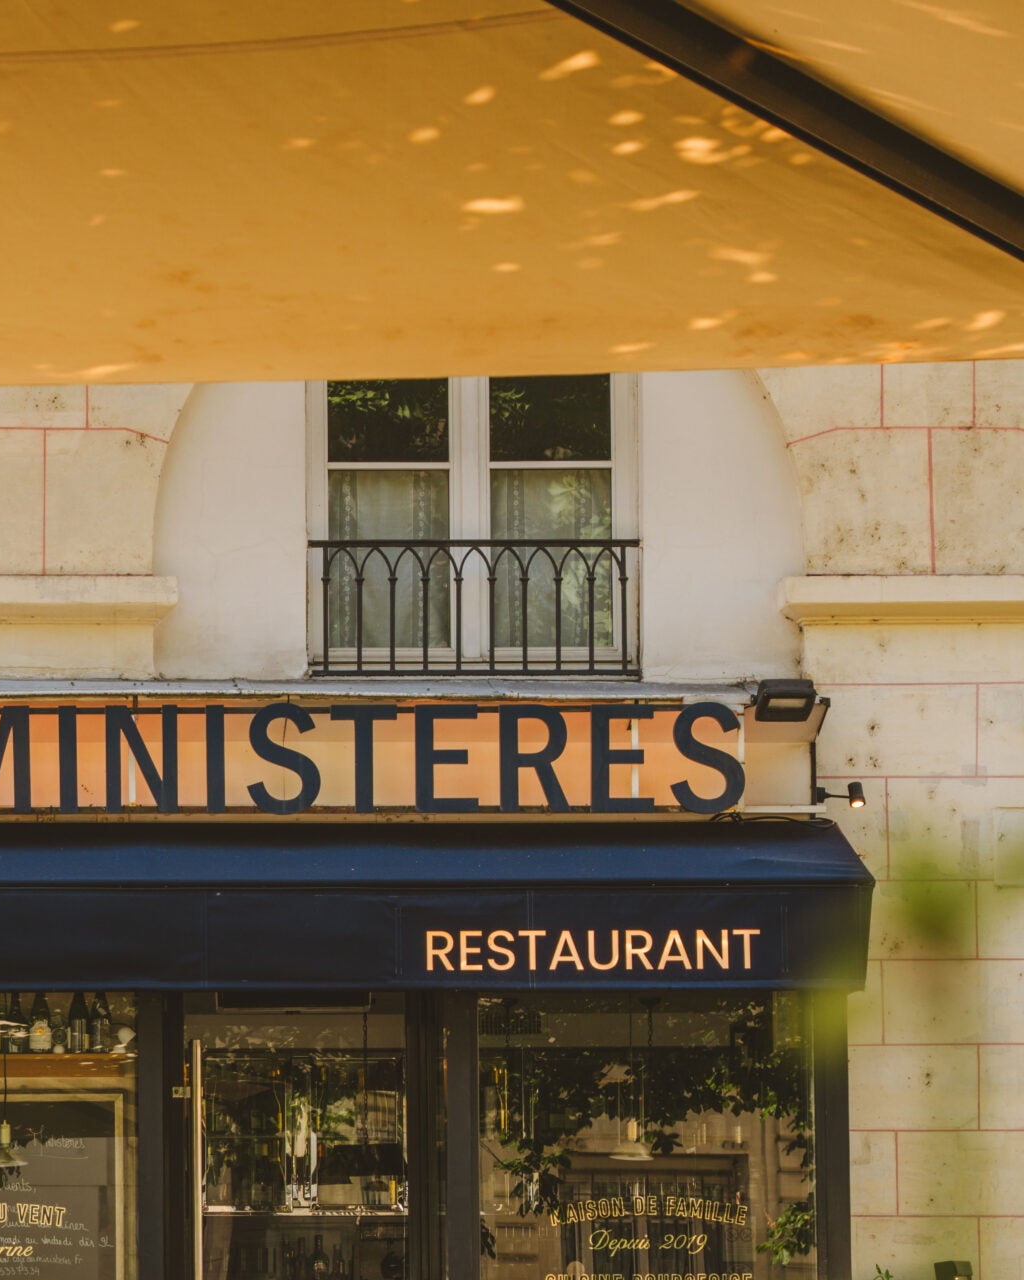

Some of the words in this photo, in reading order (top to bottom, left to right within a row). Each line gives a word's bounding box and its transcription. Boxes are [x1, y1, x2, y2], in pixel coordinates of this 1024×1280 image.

[426, 929, 761, 972] RESTAURANT
[16, 1203, 66, 1228] VENT
[549, 1196, 626, 1227] MAISON
[633, 1195, 658, 1216] DE
[666, 1196, 749, 1227] FAMILLE
[588, 1229, 651, 1257] Depuis
[658, 1233, 708, 1255] 2019
